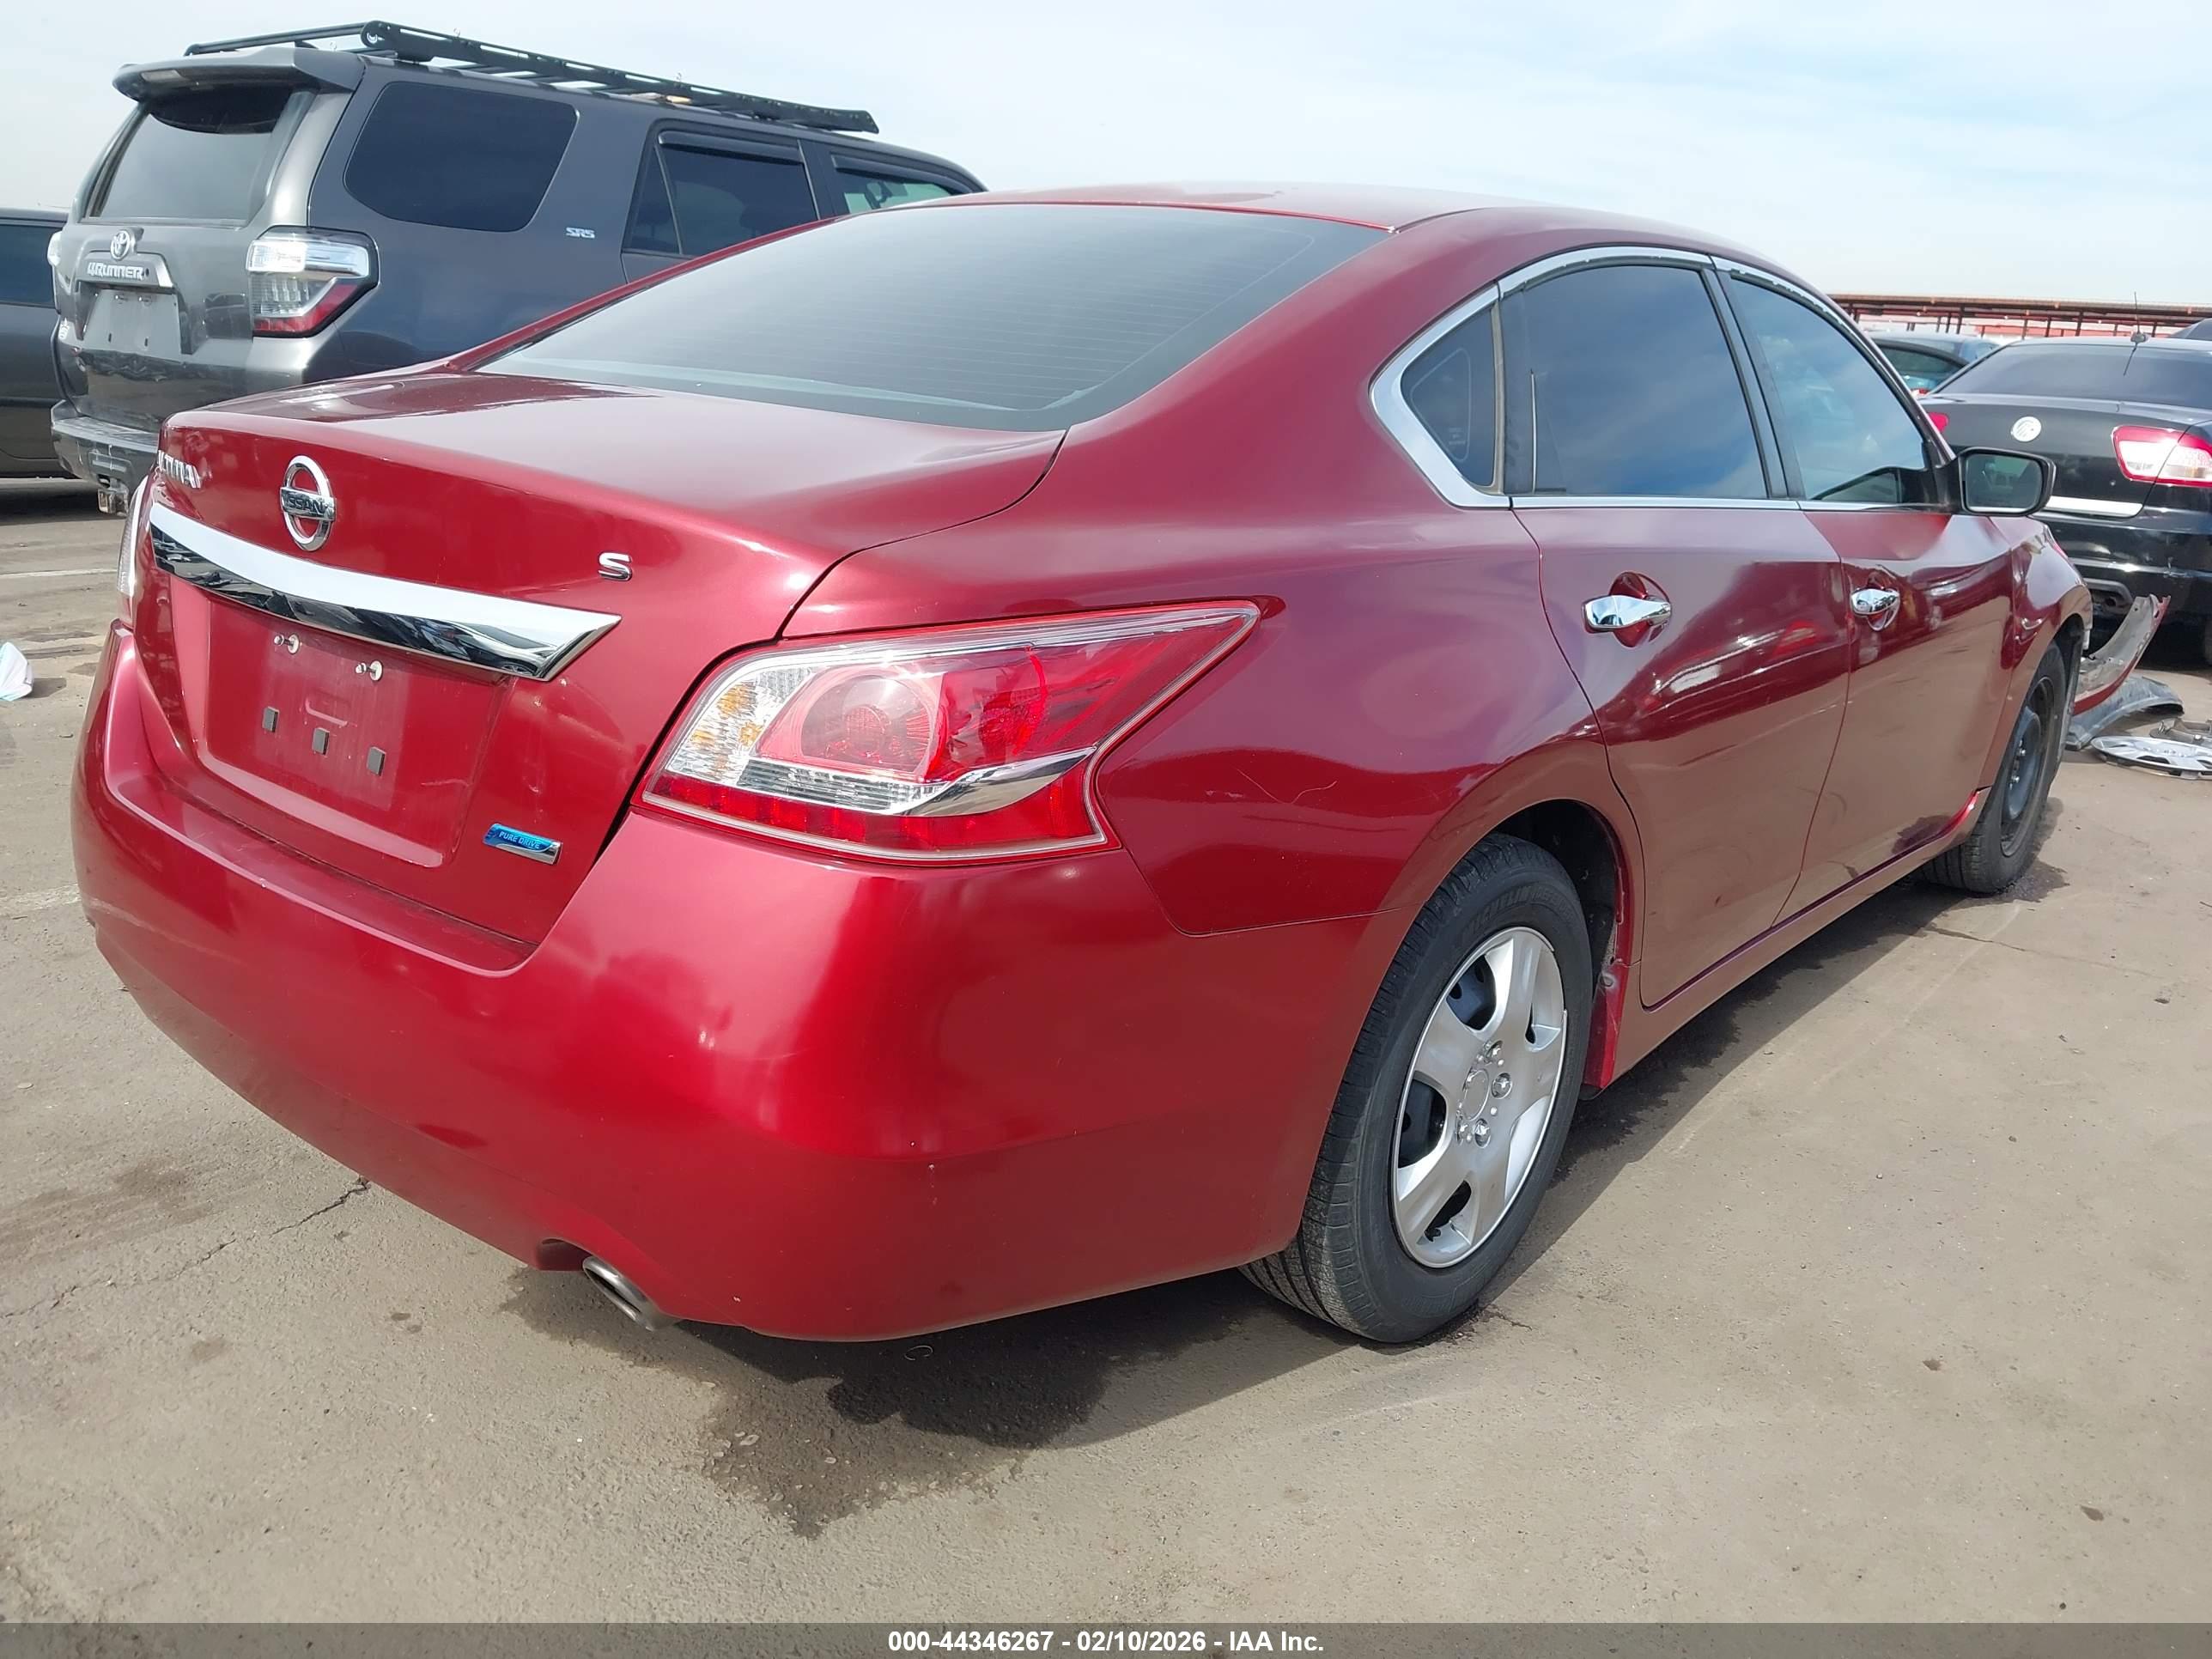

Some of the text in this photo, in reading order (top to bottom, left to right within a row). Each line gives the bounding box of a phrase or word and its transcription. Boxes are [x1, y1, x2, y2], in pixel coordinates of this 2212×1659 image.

[566, 227, 595, 239] SR5
[283, 495, 326, 515] SSAN
[599, 552, 632, 581] S
[499, 831, 542, 849] PURE DRIVE
